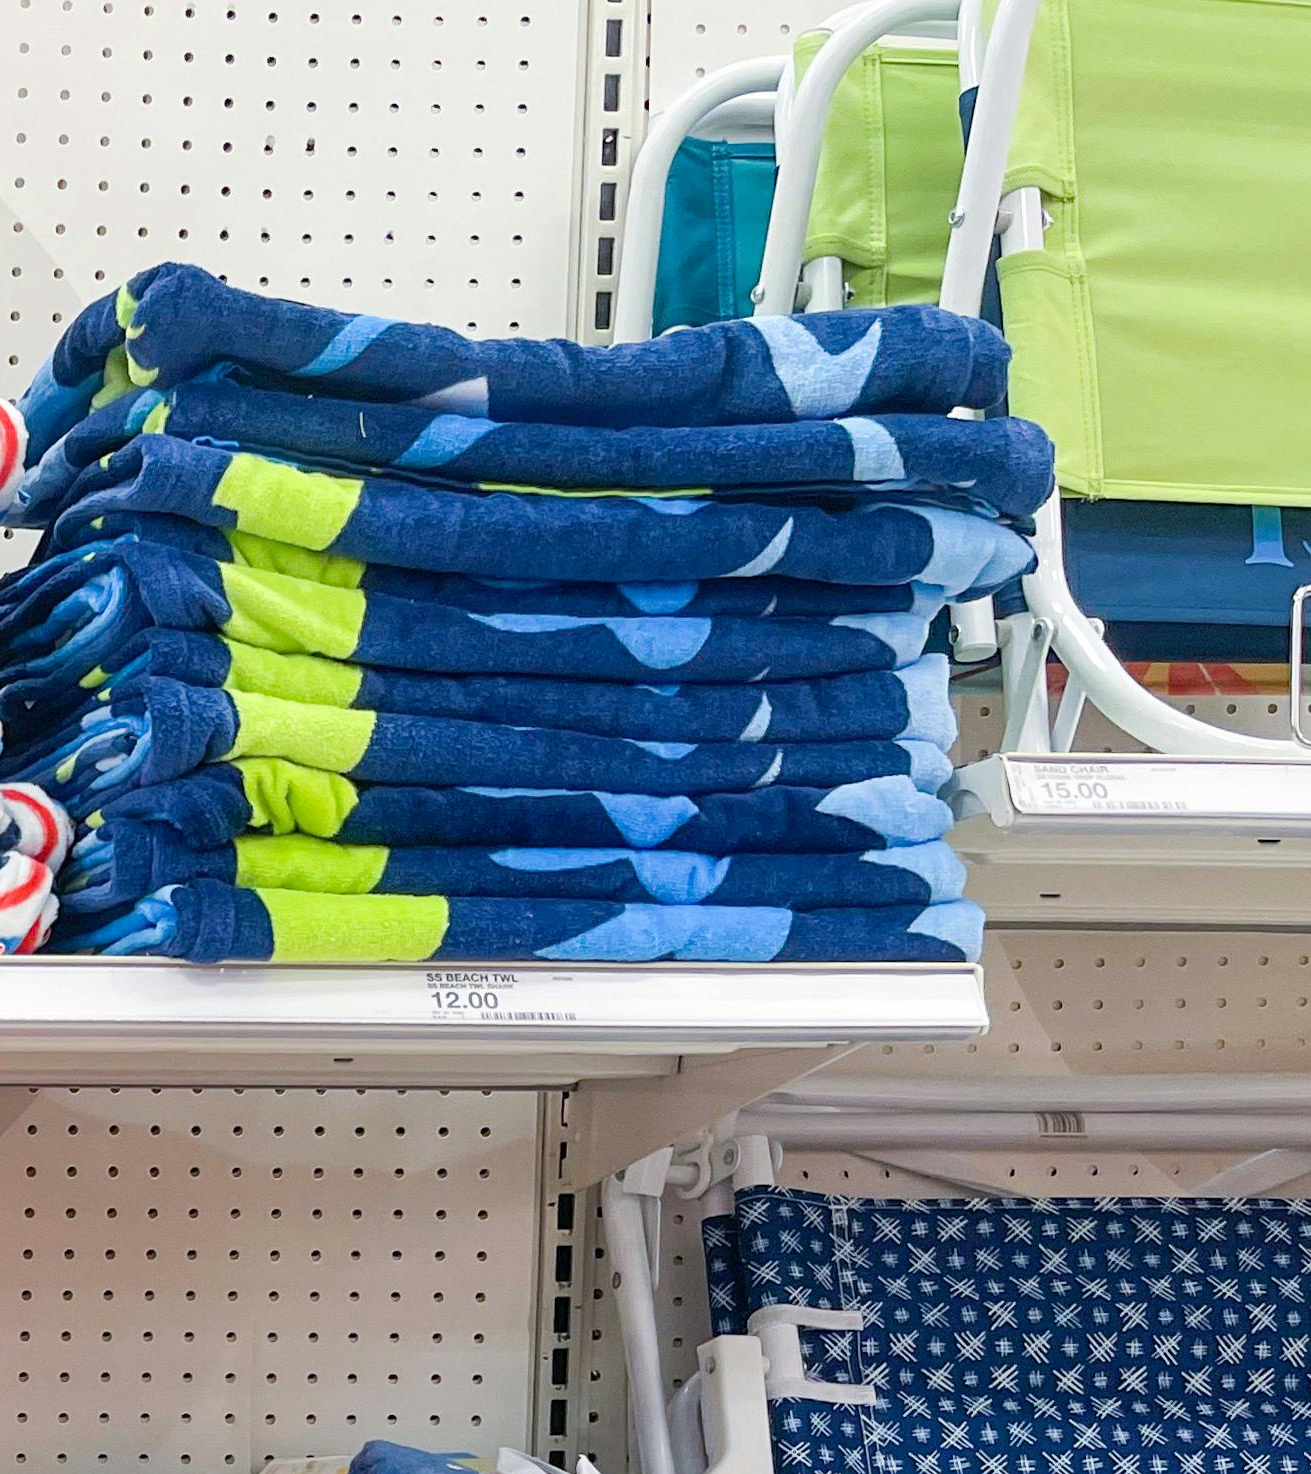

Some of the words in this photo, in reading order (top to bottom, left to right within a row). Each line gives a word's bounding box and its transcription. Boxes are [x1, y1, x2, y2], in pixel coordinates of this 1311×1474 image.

[1070, 765, 1109, 774] CHAIR
[1041, 782, 1109, 799] 15.00
[427, 973, 442, 982] SS
[446, 973, 489, 982] BEACH
[493, 973, 519, 982] TWL
[431, 991, 499, 1009] 12.00
